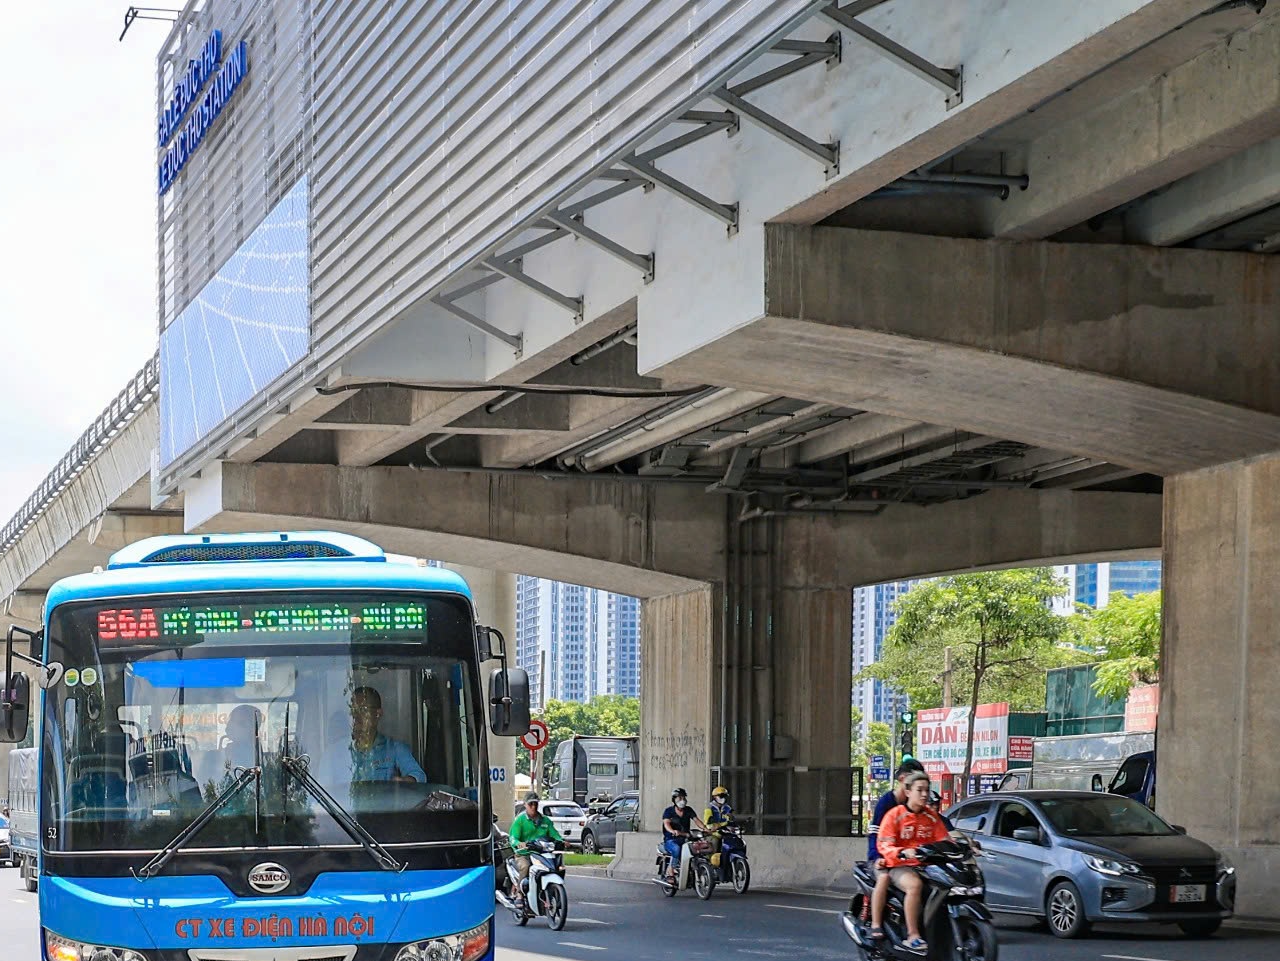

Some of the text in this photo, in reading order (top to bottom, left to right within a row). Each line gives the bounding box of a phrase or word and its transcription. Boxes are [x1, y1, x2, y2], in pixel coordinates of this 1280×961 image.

[185, 106, 205, 155] THO
[202, 40, 247, 129] STATION
[98, 608, 160, 639] 56A
[163, 606, 191, 636] MỸ
[195, 606, 239, 634] ĐÌNH
[363, 602, 391, 630] NÚI
[921, 722, 958, 745] DÁN
[47, 826, 57, 839] 52
[252, 873, 288, 882] SAMCO
[174, 911, 375, 942] CT XE ĐIỆN HÀ NỘI
